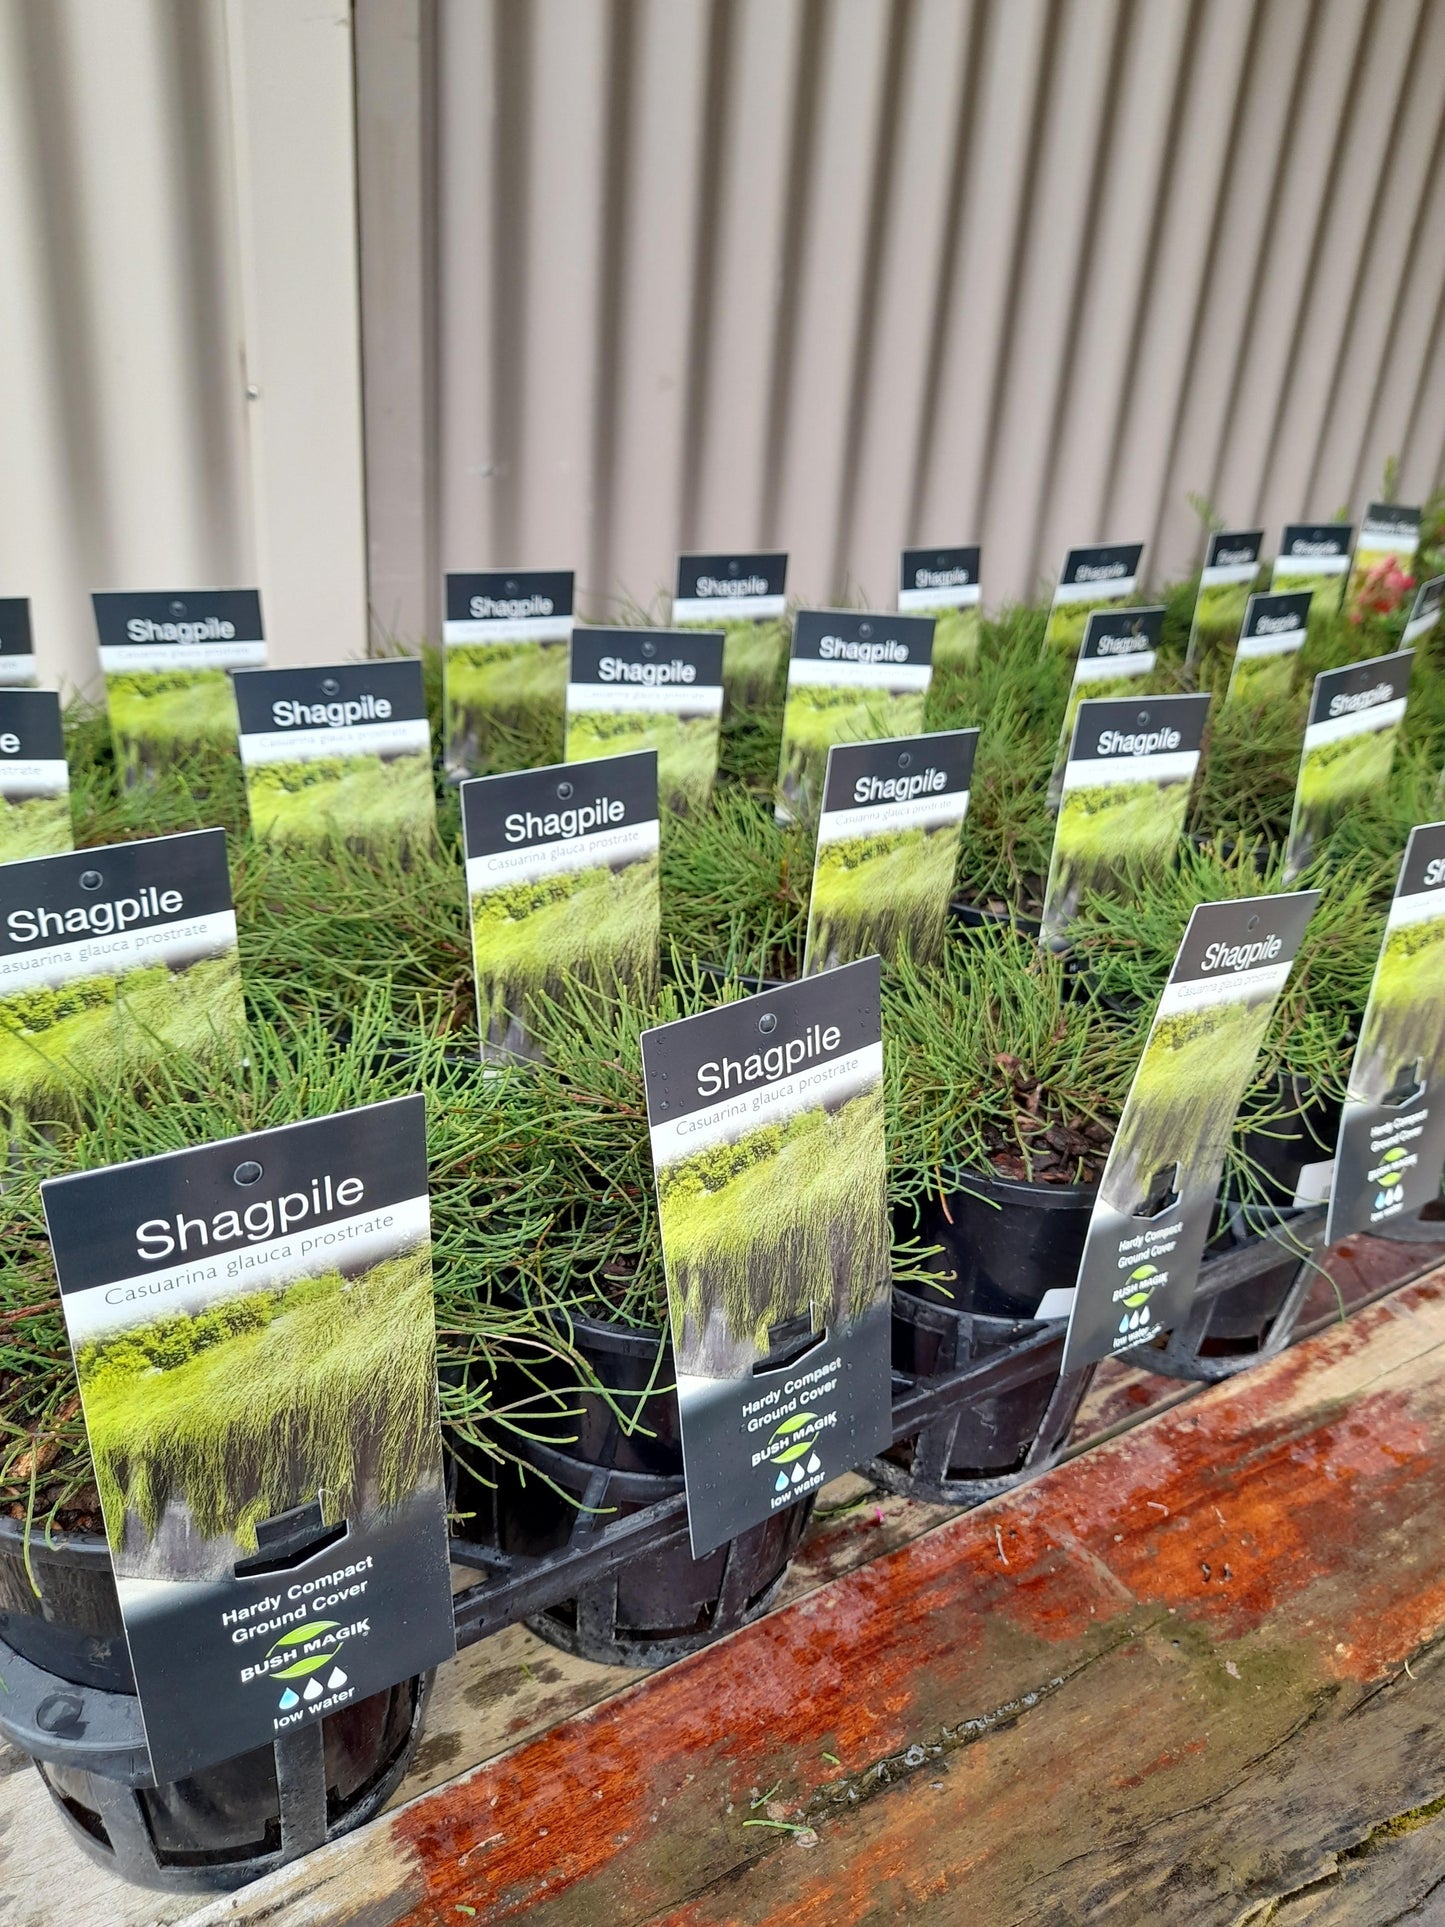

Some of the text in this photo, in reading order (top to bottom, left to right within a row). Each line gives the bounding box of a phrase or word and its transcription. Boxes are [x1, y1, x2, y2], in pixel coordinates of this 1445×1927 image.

[470, 594, 554, 619] Shagpile
[696, 575, 768, 599] Shagpile
[127, 617, 235, 645] Shagpile
[819, 635, 909, 663] Shagpile
[598, 657, 697, 685] Shagpile
[272, 695, 392, 728] Shagpile
[1097, 727, 1181, 756] Shagpile
[854, 767, 947, 802] Shagpile
[505, 797, 625, 843] Shagpile
[487, 831, 639, 871] Casuarina glauca prostrate
[7, 887, 183, 943] Shagpile
[79, 940, 129, 962] glauca
[135, 922, 208, 950] prostrate
[1201, 934, 1282, 971] Shagpile
[697, 1024, 841, 1097] Shagpile
[676, 1058, 859, 1136] Casuarina glauca prostrate
[136, 1175, 364, 1260] Shagpile
[1119, 1221, 1184, 1253] Hardy Compact
[105, 1214, 394, 1305] Casuarina glauca prostrate
[1118, 1241, 1177, 1269] Ground Cover
[1112, 1282, 1138, 1303] BUSH
[742, 1357, 842, 1418] Hardy Compact
[747, 1378, 838, 1432] Ground Cover
[751, 1411, 838, 1467] BUSH MAGIK
[771, 1471, 826, 1509] low water
[222, 1556, 374, 1626] Hardy Compact
[232, 1580, 368, 1643] Ground Cover
[240, 1617, 371, 1683] BUSH MAGIK
[273, 1687, 355, 1730] low water
